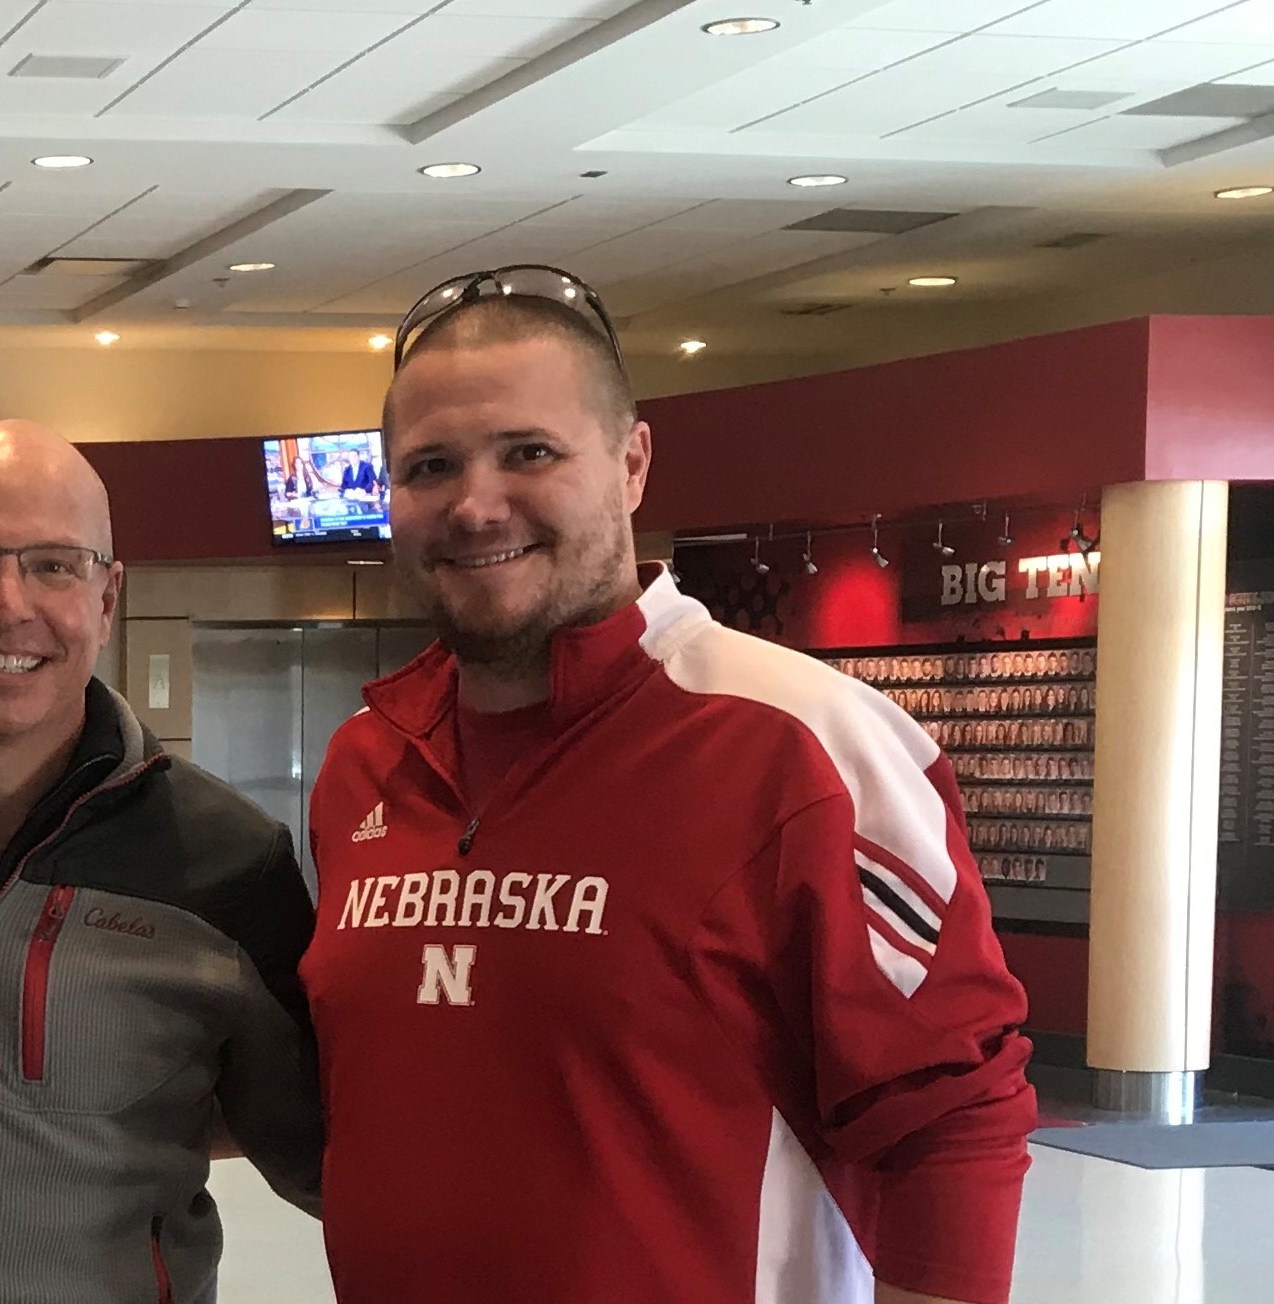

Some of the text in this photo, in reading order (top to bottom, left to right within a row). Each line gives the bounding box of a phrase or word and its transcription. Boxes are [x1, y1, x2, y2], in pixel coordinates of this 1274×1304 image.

[941, 551, 1101, 606] BIG TEN
[351, 825, 387, 842] adidas
[337, 870, 609, 936] NEBRASKA
[417, 944, 477, 1006] N
